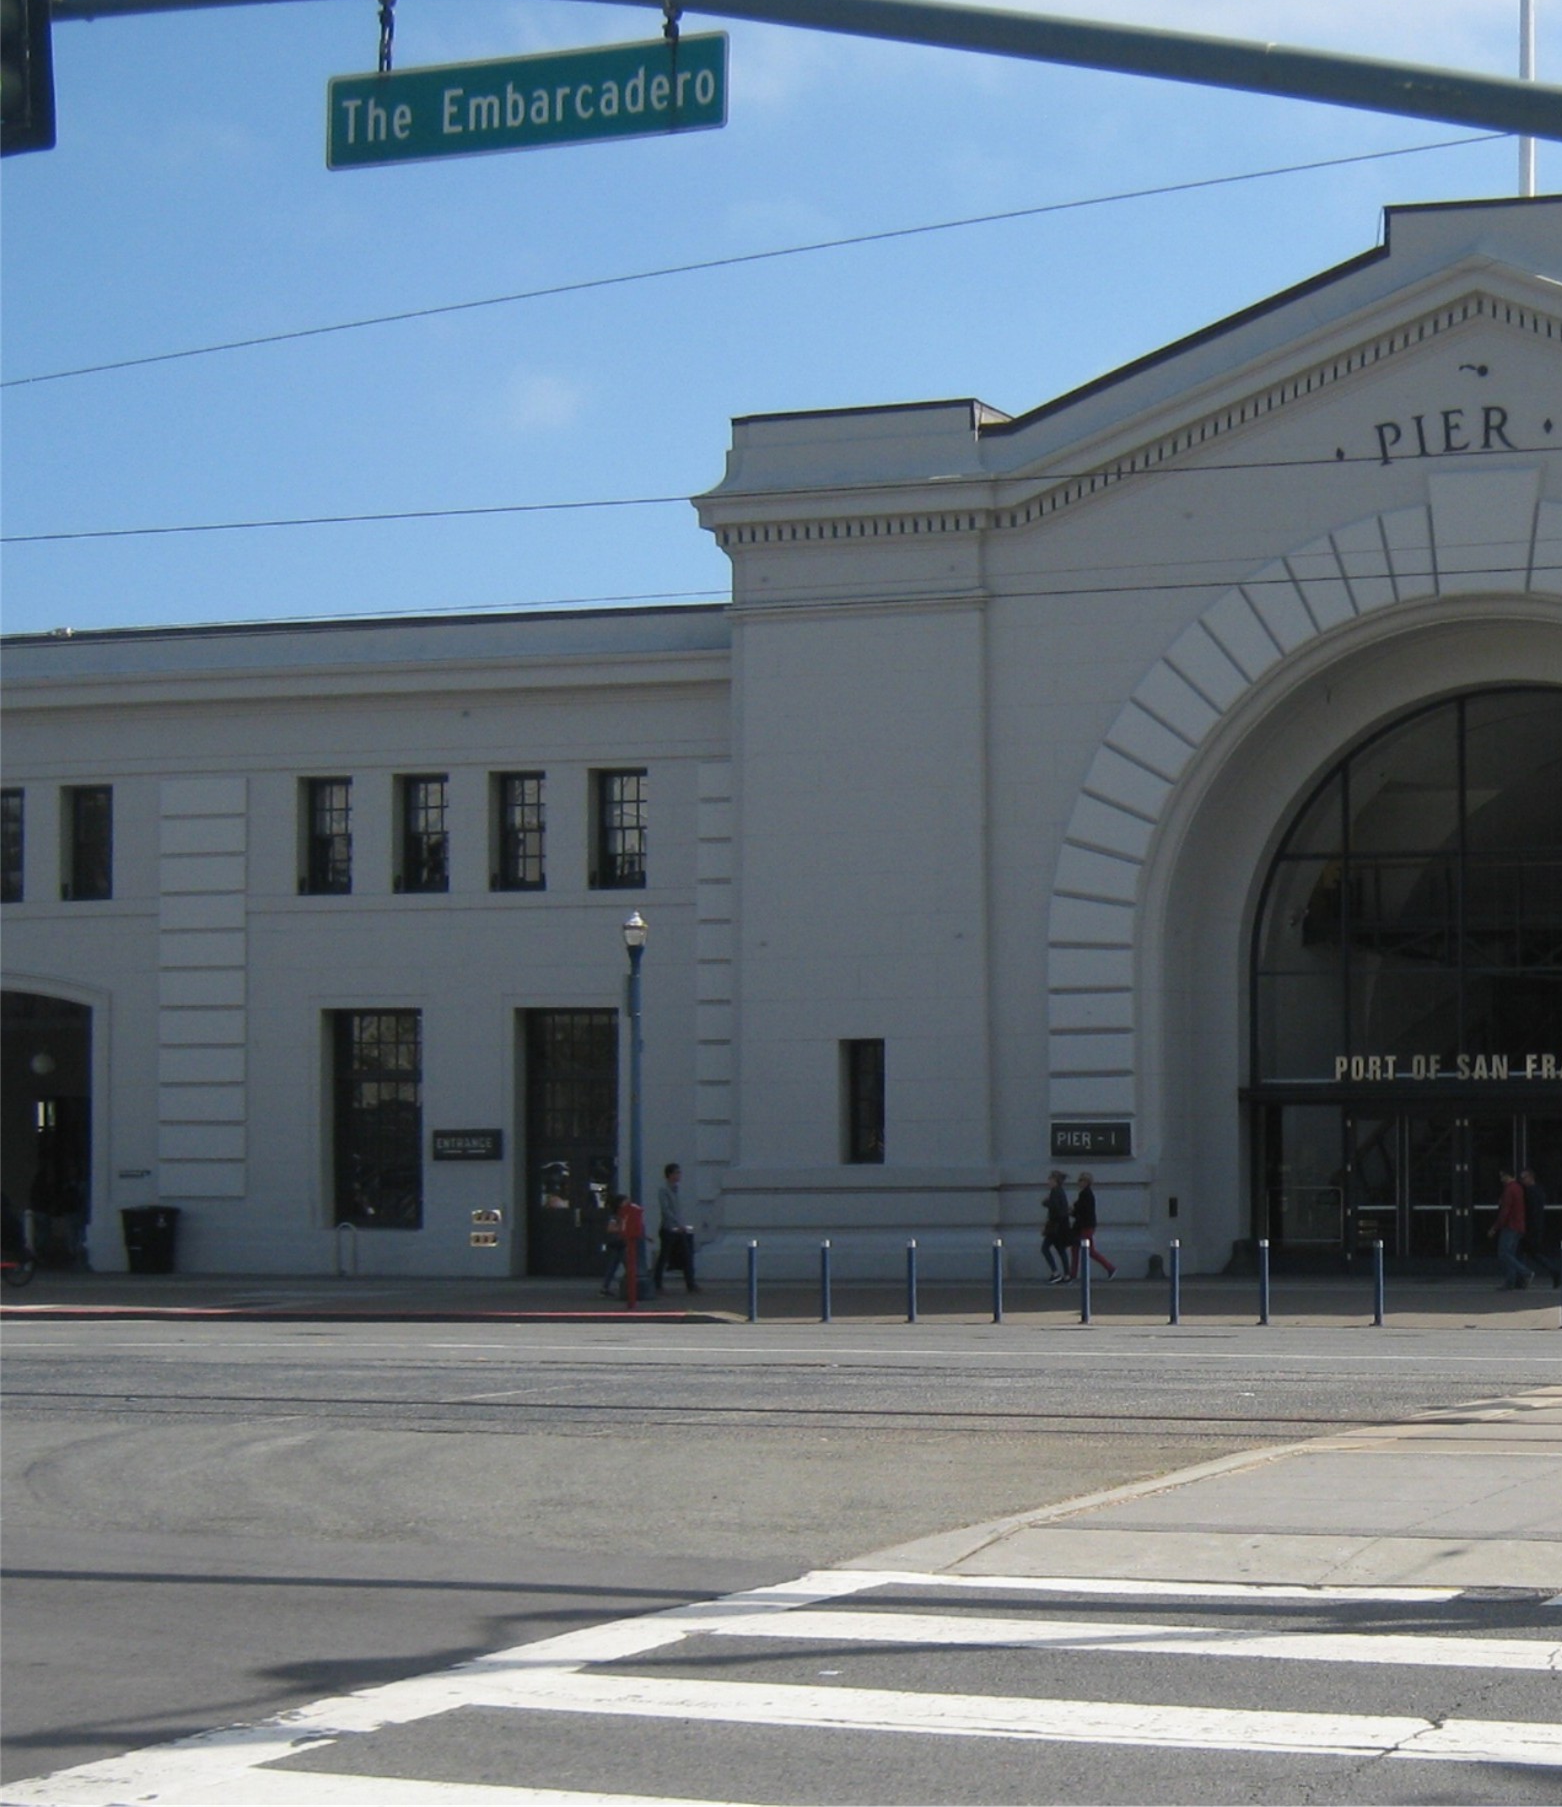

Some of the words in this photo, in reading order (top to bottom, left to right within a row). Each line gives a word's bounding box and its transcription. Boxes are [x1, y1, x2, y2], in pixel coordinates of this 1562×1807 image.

[342, 95, 412, 144] The
[442, 66, 715, 134] Embarcadero
[1374, 406, 1518, 466] PIER
[1335, 1056, 1397, 1081] PORT
[1412, 1055, 1441, 1080] OF
[1457, 1054, 1509, 1080] SAN
[436, 1137, 494, 1149] ENTRANCE
[1056, 1131, 1092, 1149] PIER
